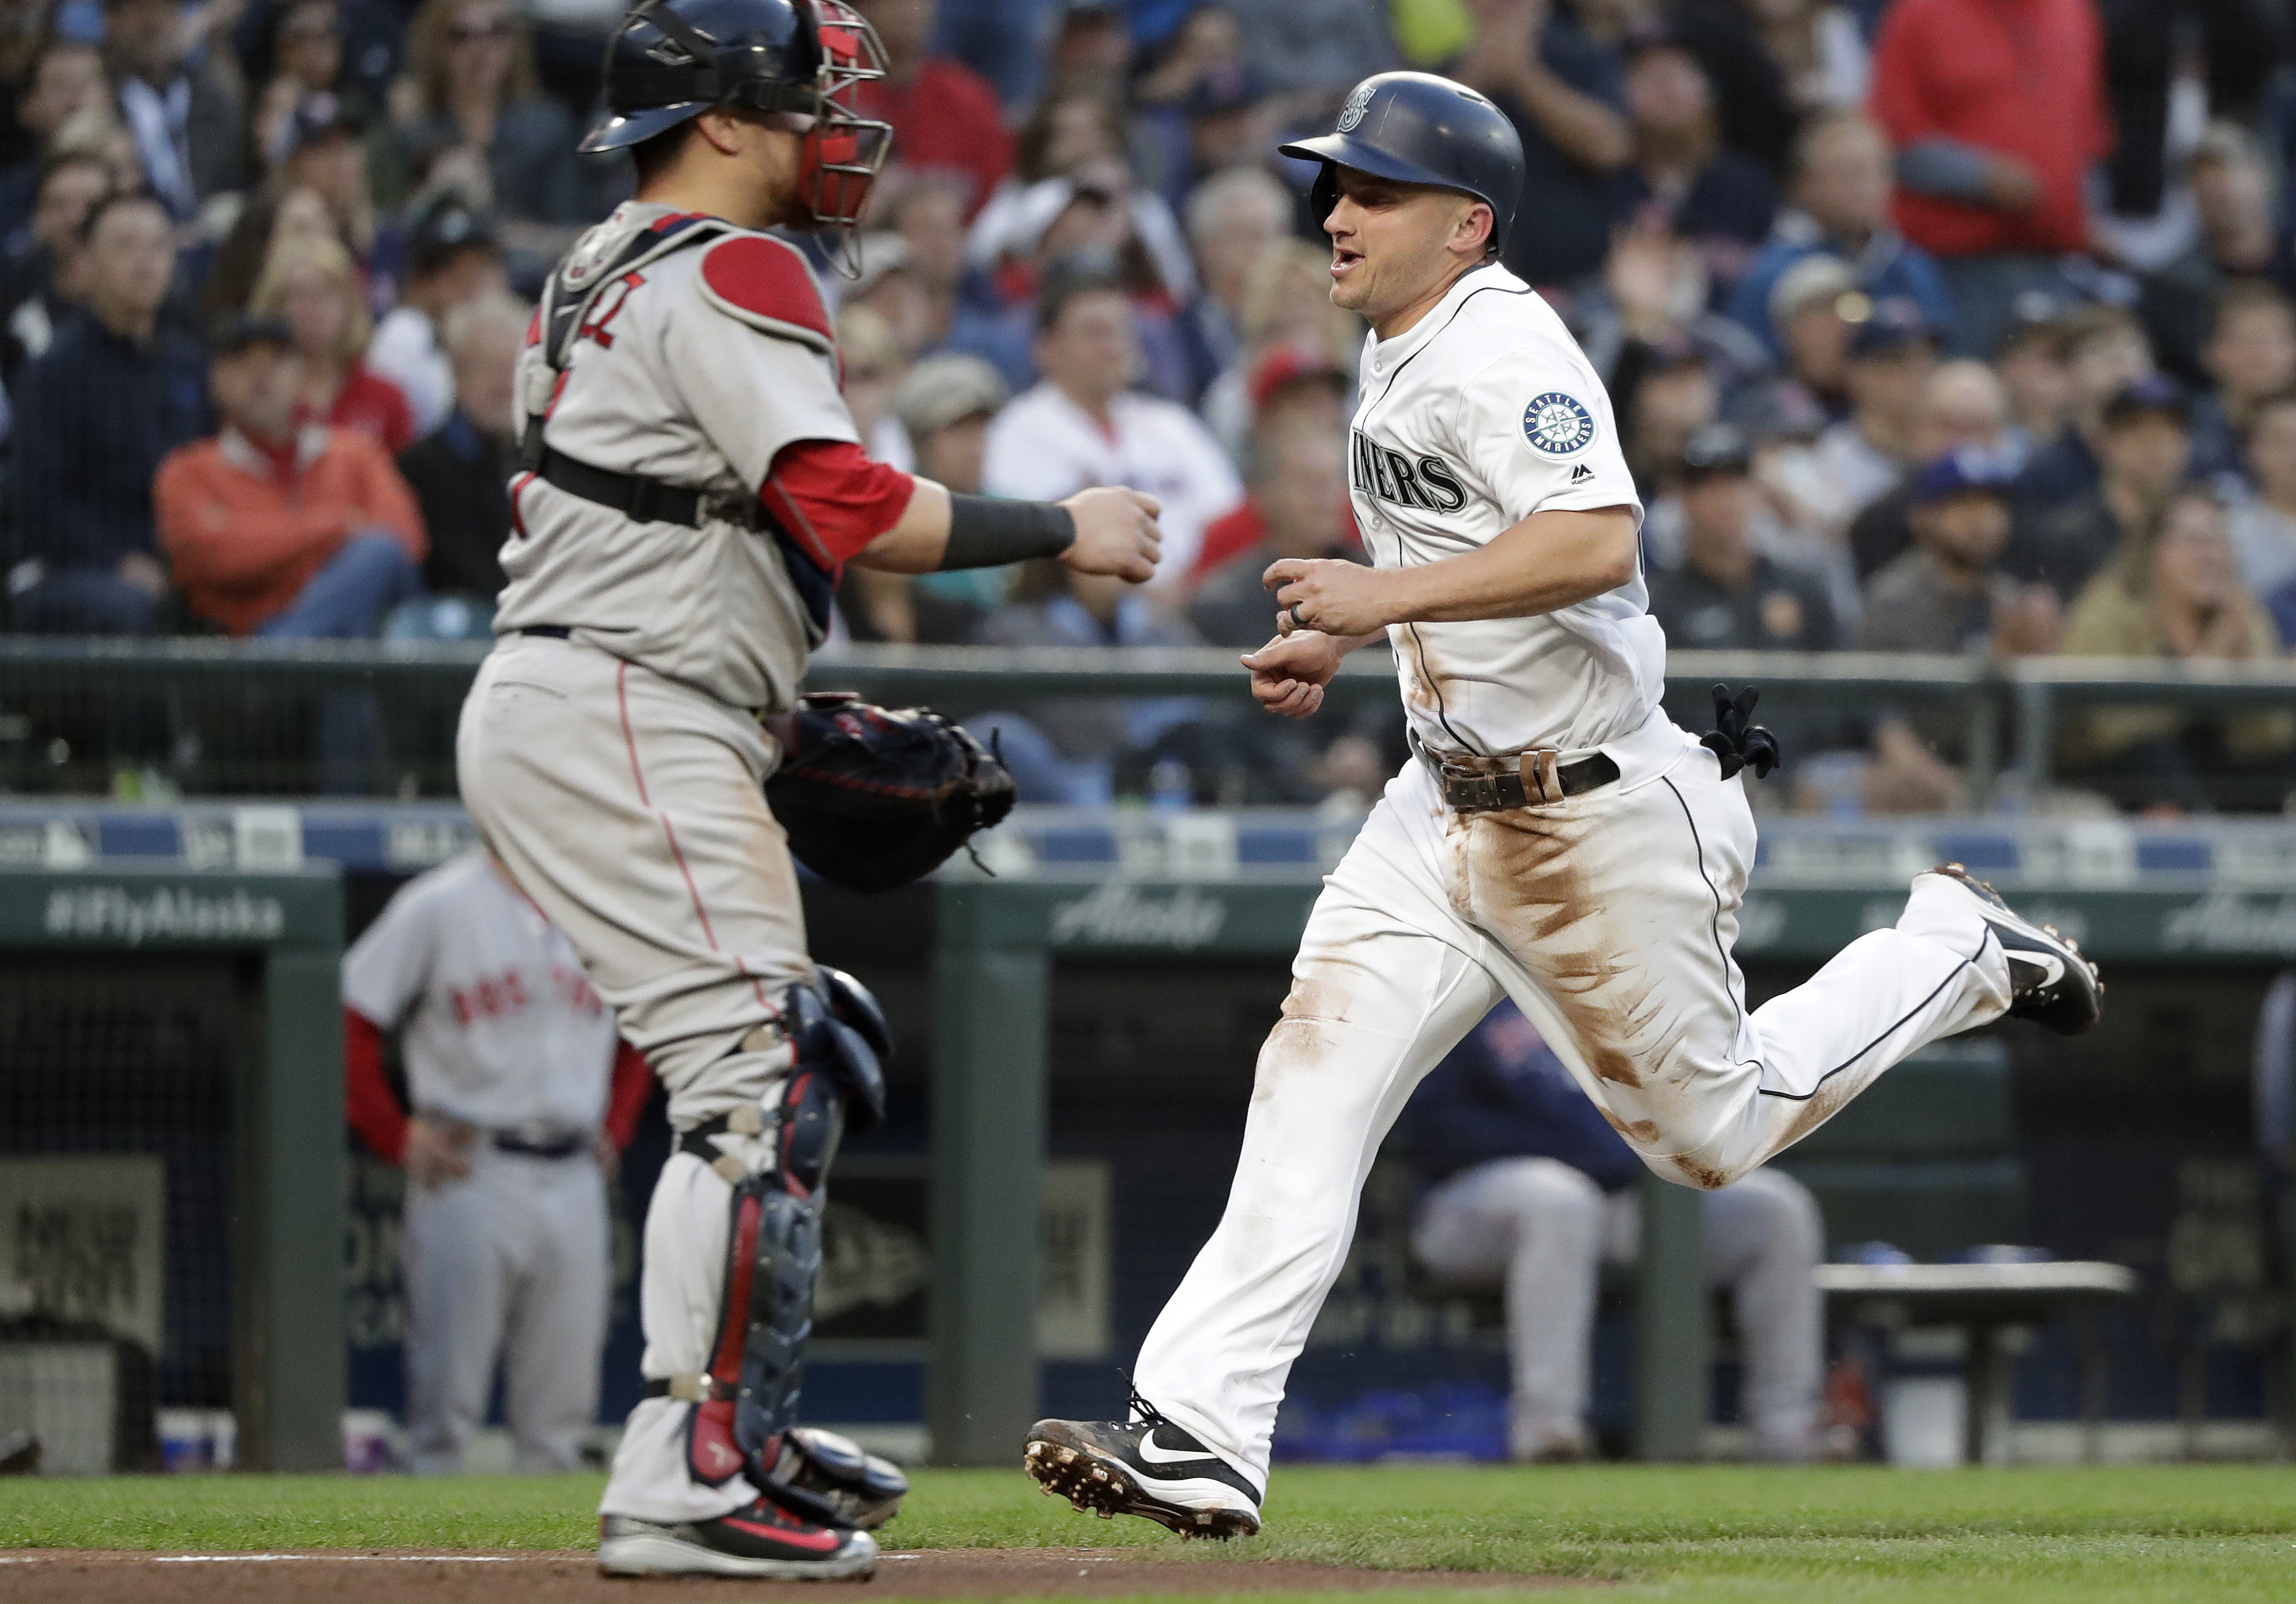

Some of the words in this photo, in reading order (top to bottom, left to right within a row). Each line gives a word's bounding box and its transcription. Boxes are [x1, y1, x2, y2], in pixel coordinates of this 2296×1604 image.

[1525, 394, 1581, 424] SEATTLE
[1534, 422, 1592, 452] MARINERS
[1571, 473, 1597, 485] Majestic
